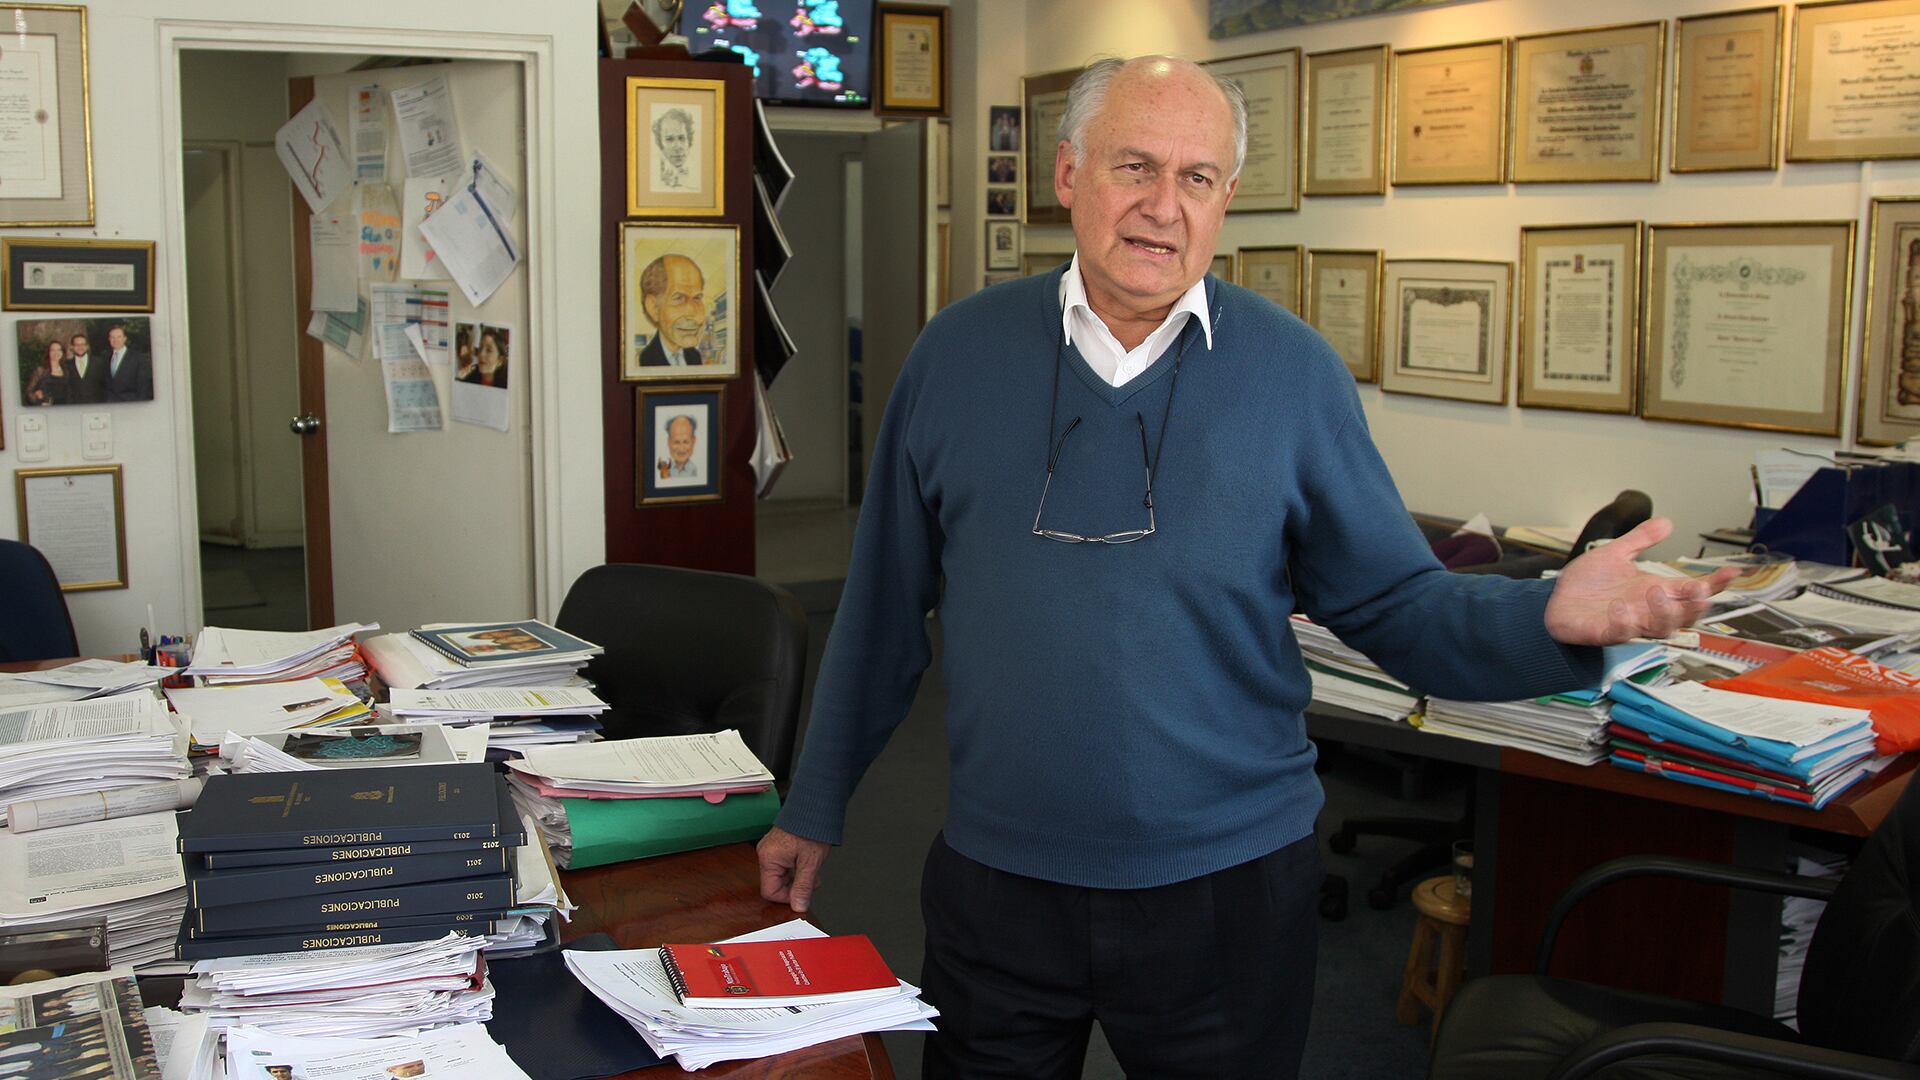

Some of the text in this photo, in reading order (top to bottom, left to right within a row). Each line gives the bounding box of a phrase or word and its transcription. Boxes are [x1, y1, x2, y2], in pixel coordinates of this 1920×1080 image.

[303, 832, 382, 845] PUBLICACIONES
[332, 841, 500, 860] PUBLICACIONES 2012
[315, 859, 482, 884] PUBLICACIONES 2011
[320, 892, 484, 913] PUBLICACIONES 2010
[326, 922, 378, 931] PUBLICACIONES
[302, 934, 382, 949] PUBLICACIONES
